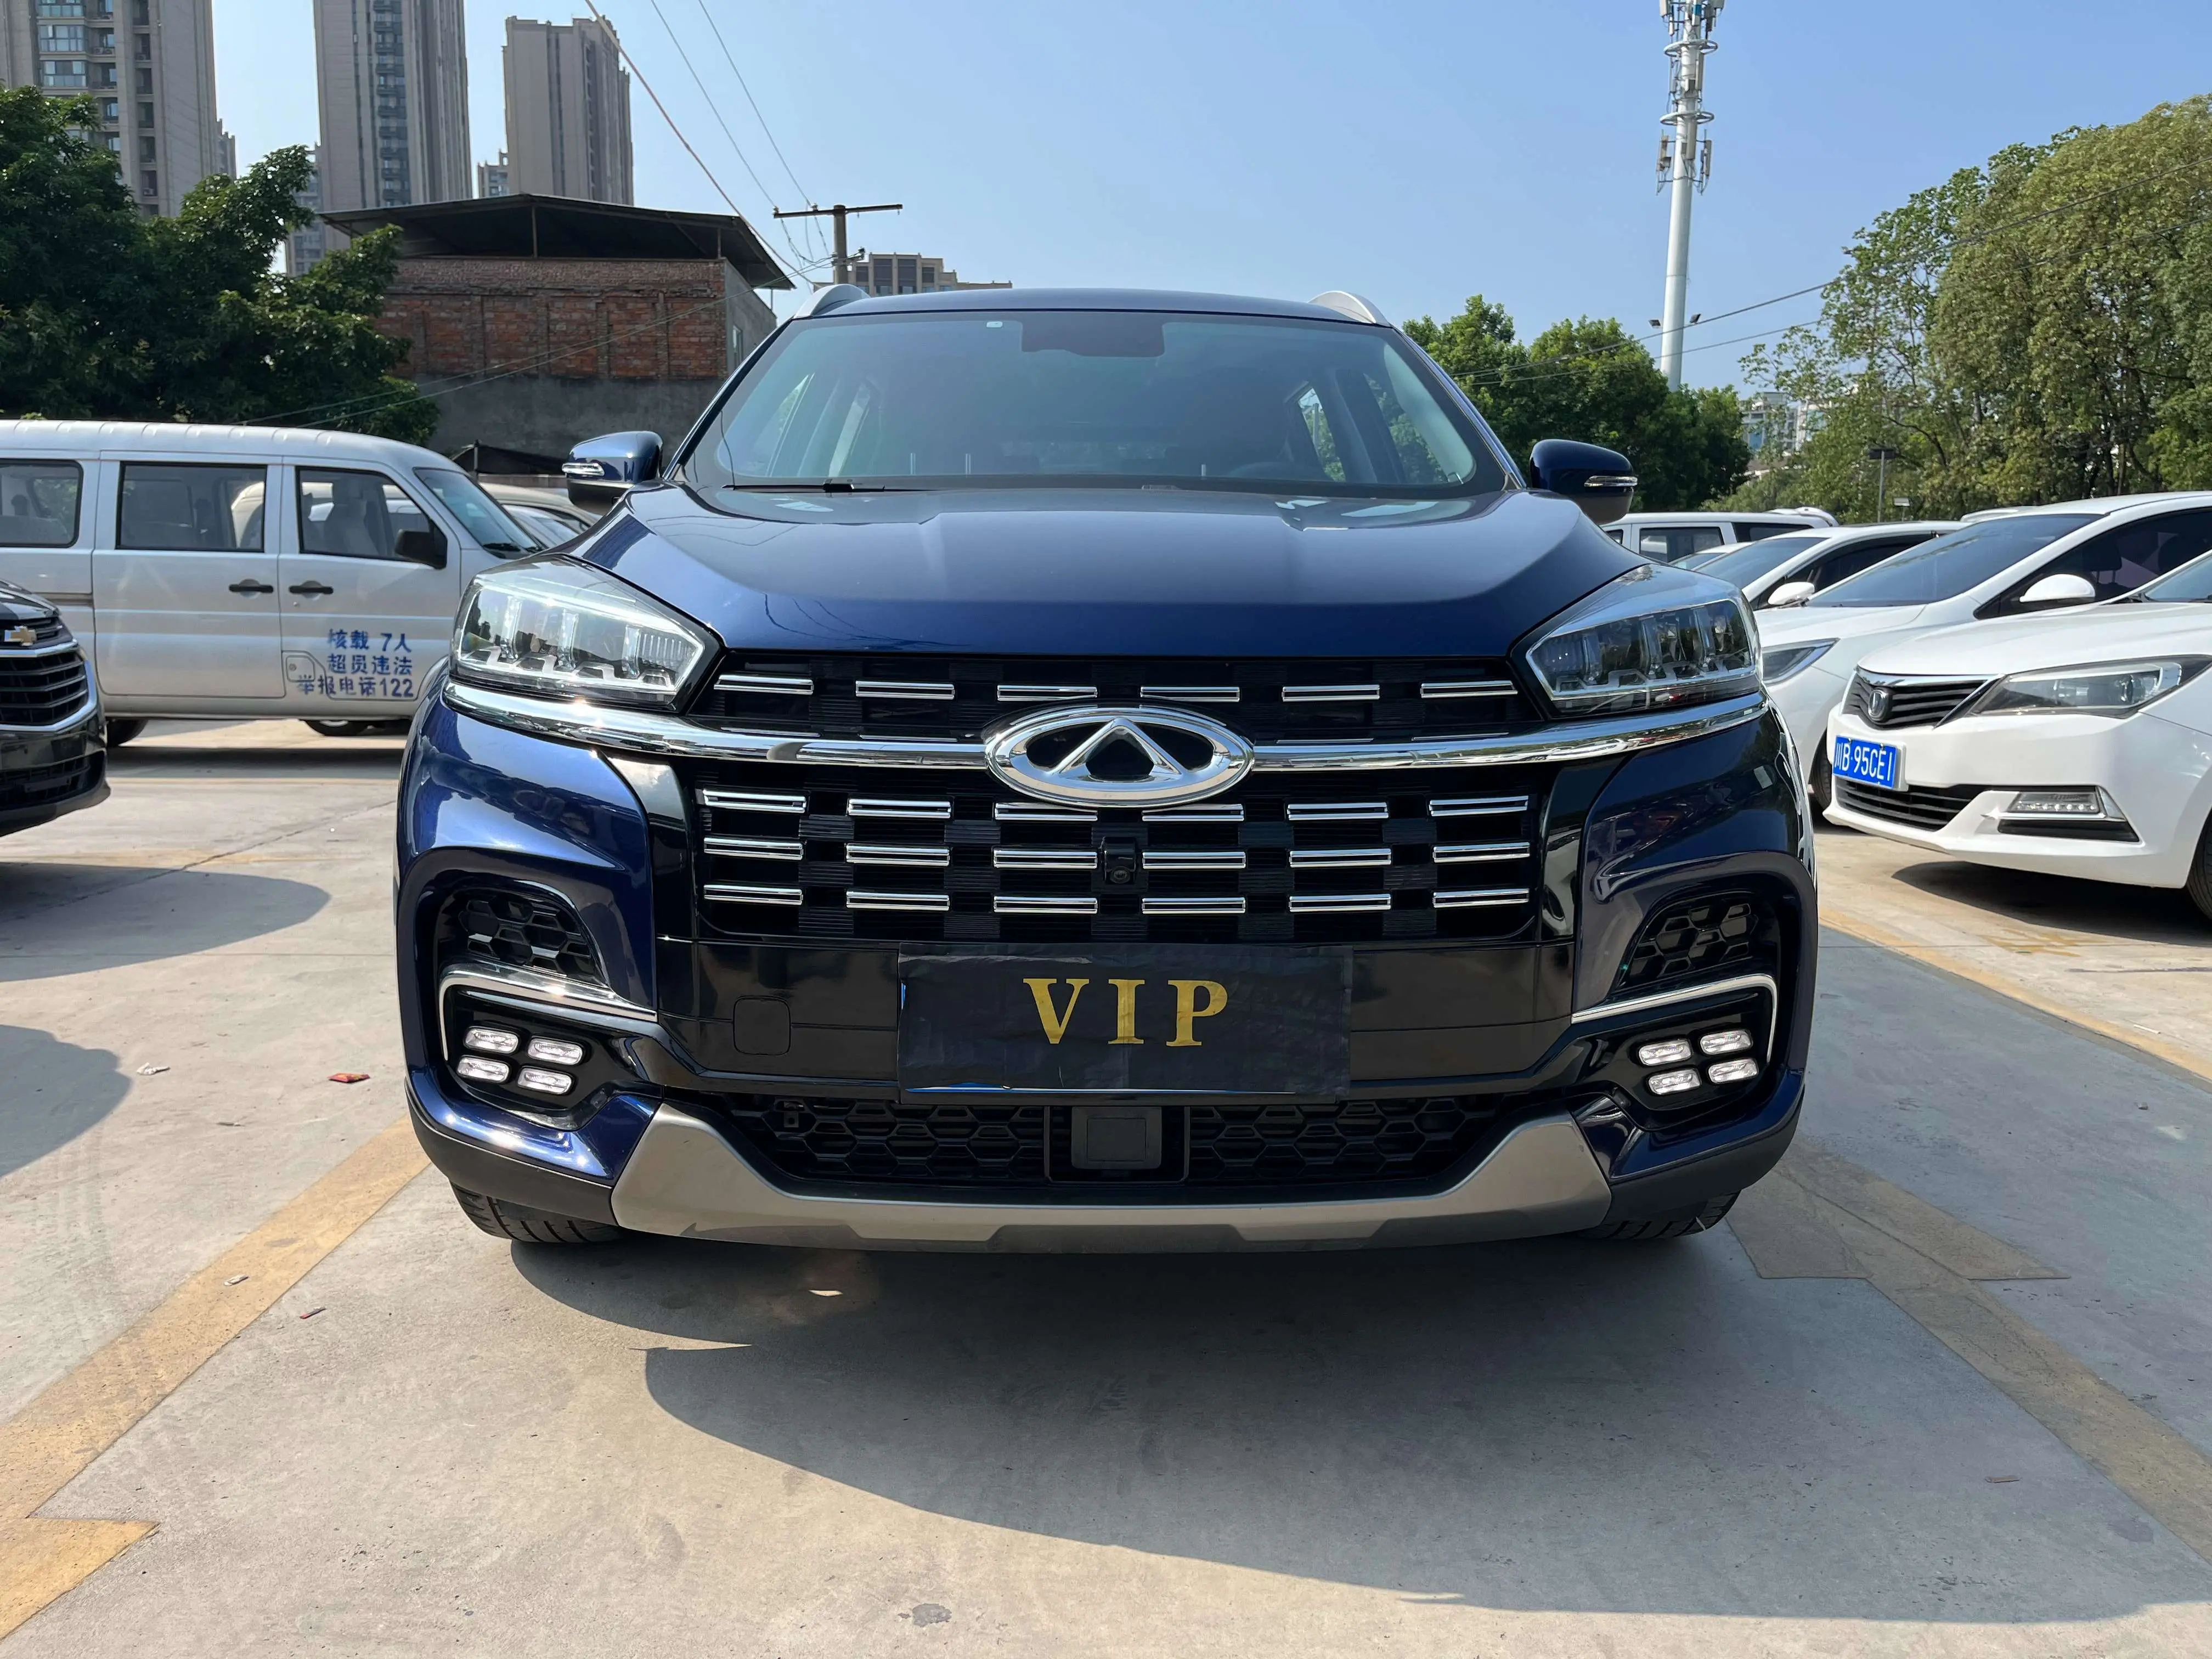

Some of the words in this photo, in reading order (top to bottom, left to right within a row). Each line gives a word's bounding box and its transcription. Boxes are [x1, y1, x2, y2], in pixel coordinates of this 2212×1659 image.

[328, 629, 370, 650] 核载
[381, 633, 411, 653] 7人
[327, 653, 413, 675] 超员违法
[297, 674, 414, 697] 举报电话122
[1023, 978, 1228, 1047] VIP
